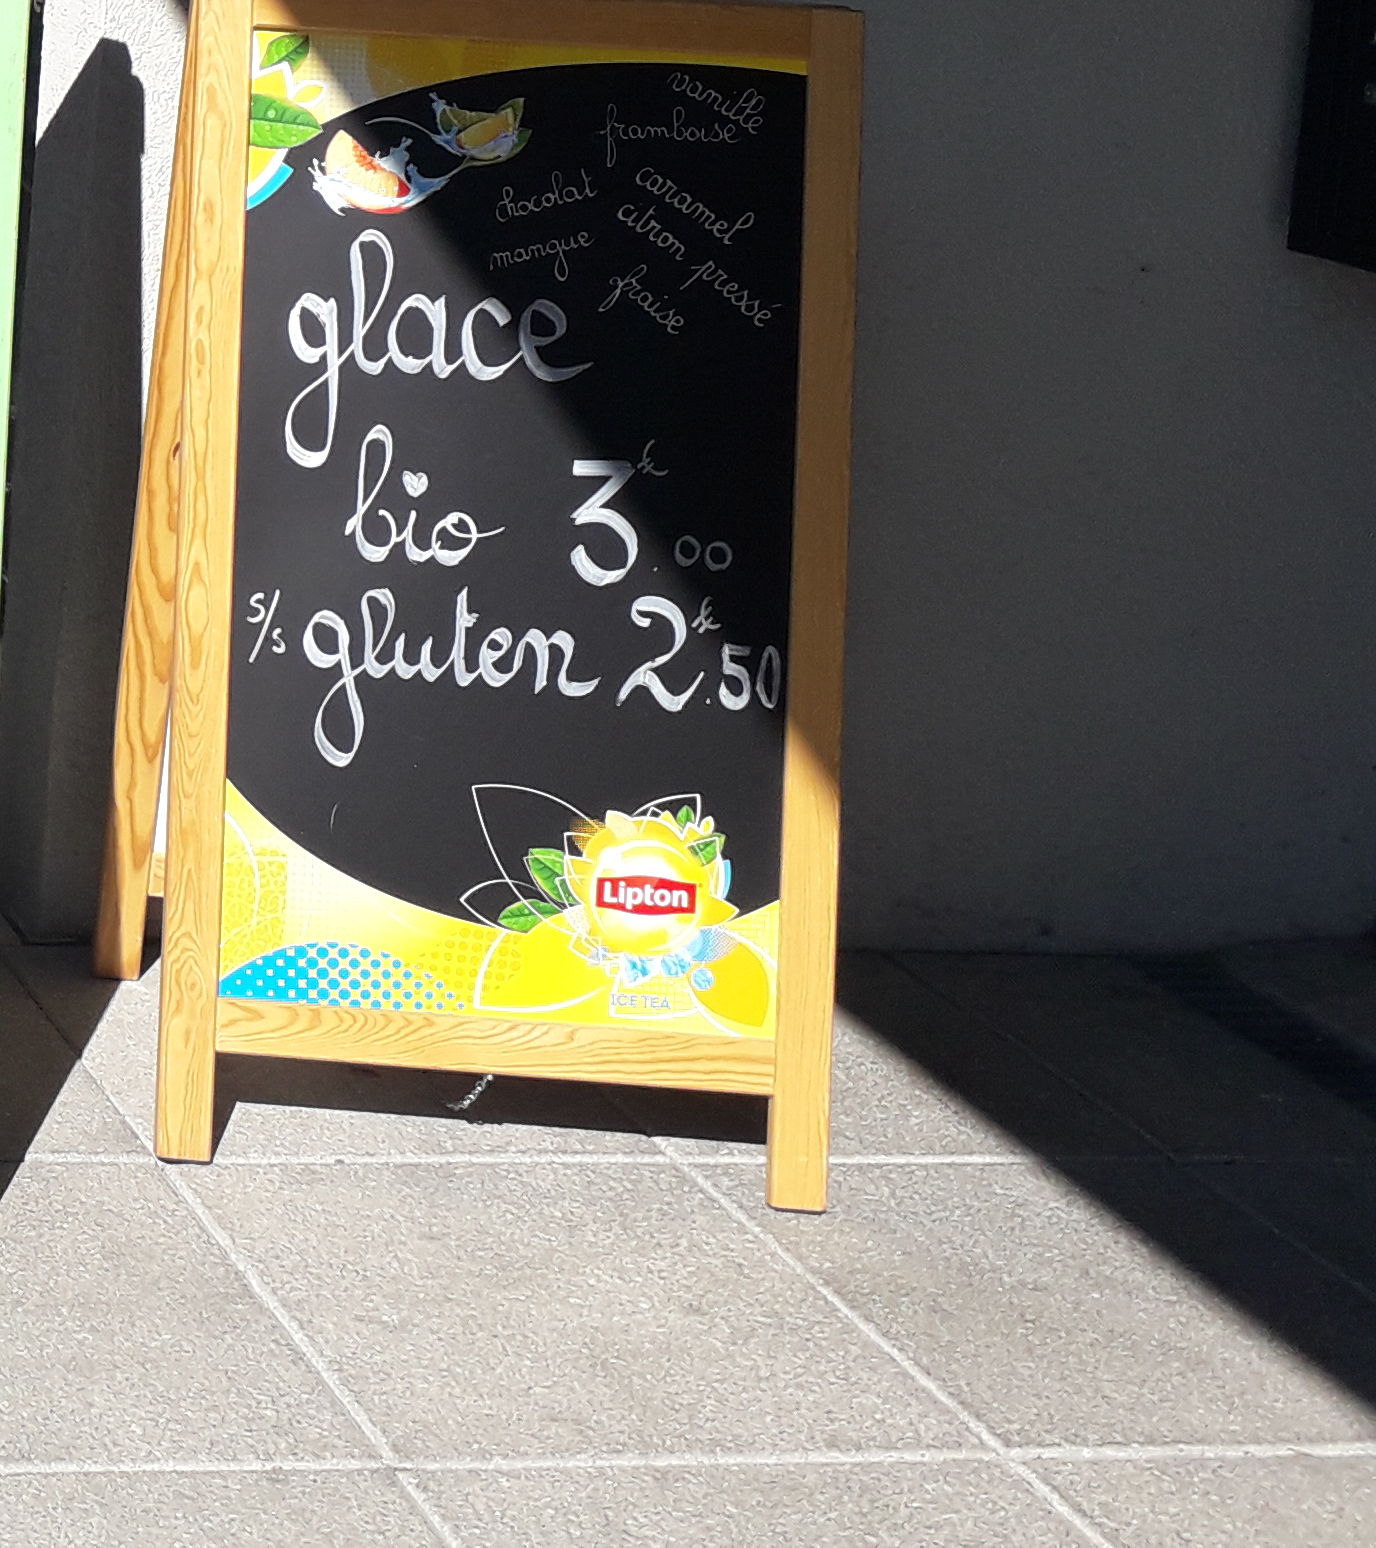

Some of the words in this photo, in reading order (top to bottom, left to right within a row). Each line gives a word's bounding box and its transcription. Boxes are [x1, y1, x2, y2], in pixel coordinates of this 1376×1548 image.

[598, 102, 742, 166] framboise
[666, 69, 766, 135] vanille
[494, 169, 599, 223] chocolat
[635, 166, 755, 246] caramel
[489, 229, 596, 282] mangue
[616, 201, 687, 263] citron
[679, 259, 784, 328] pressé
[597, 263, 687, 336] fraise
[284, 228, 596, 469] glace
[344, 423, 506, 567] bio
[302, 585, 602, 768] gluten
[603, 880, 690, 911] Lipton
[610, 993, 638, 1007] ICE
[641, 995, 672, 1010] TEA
